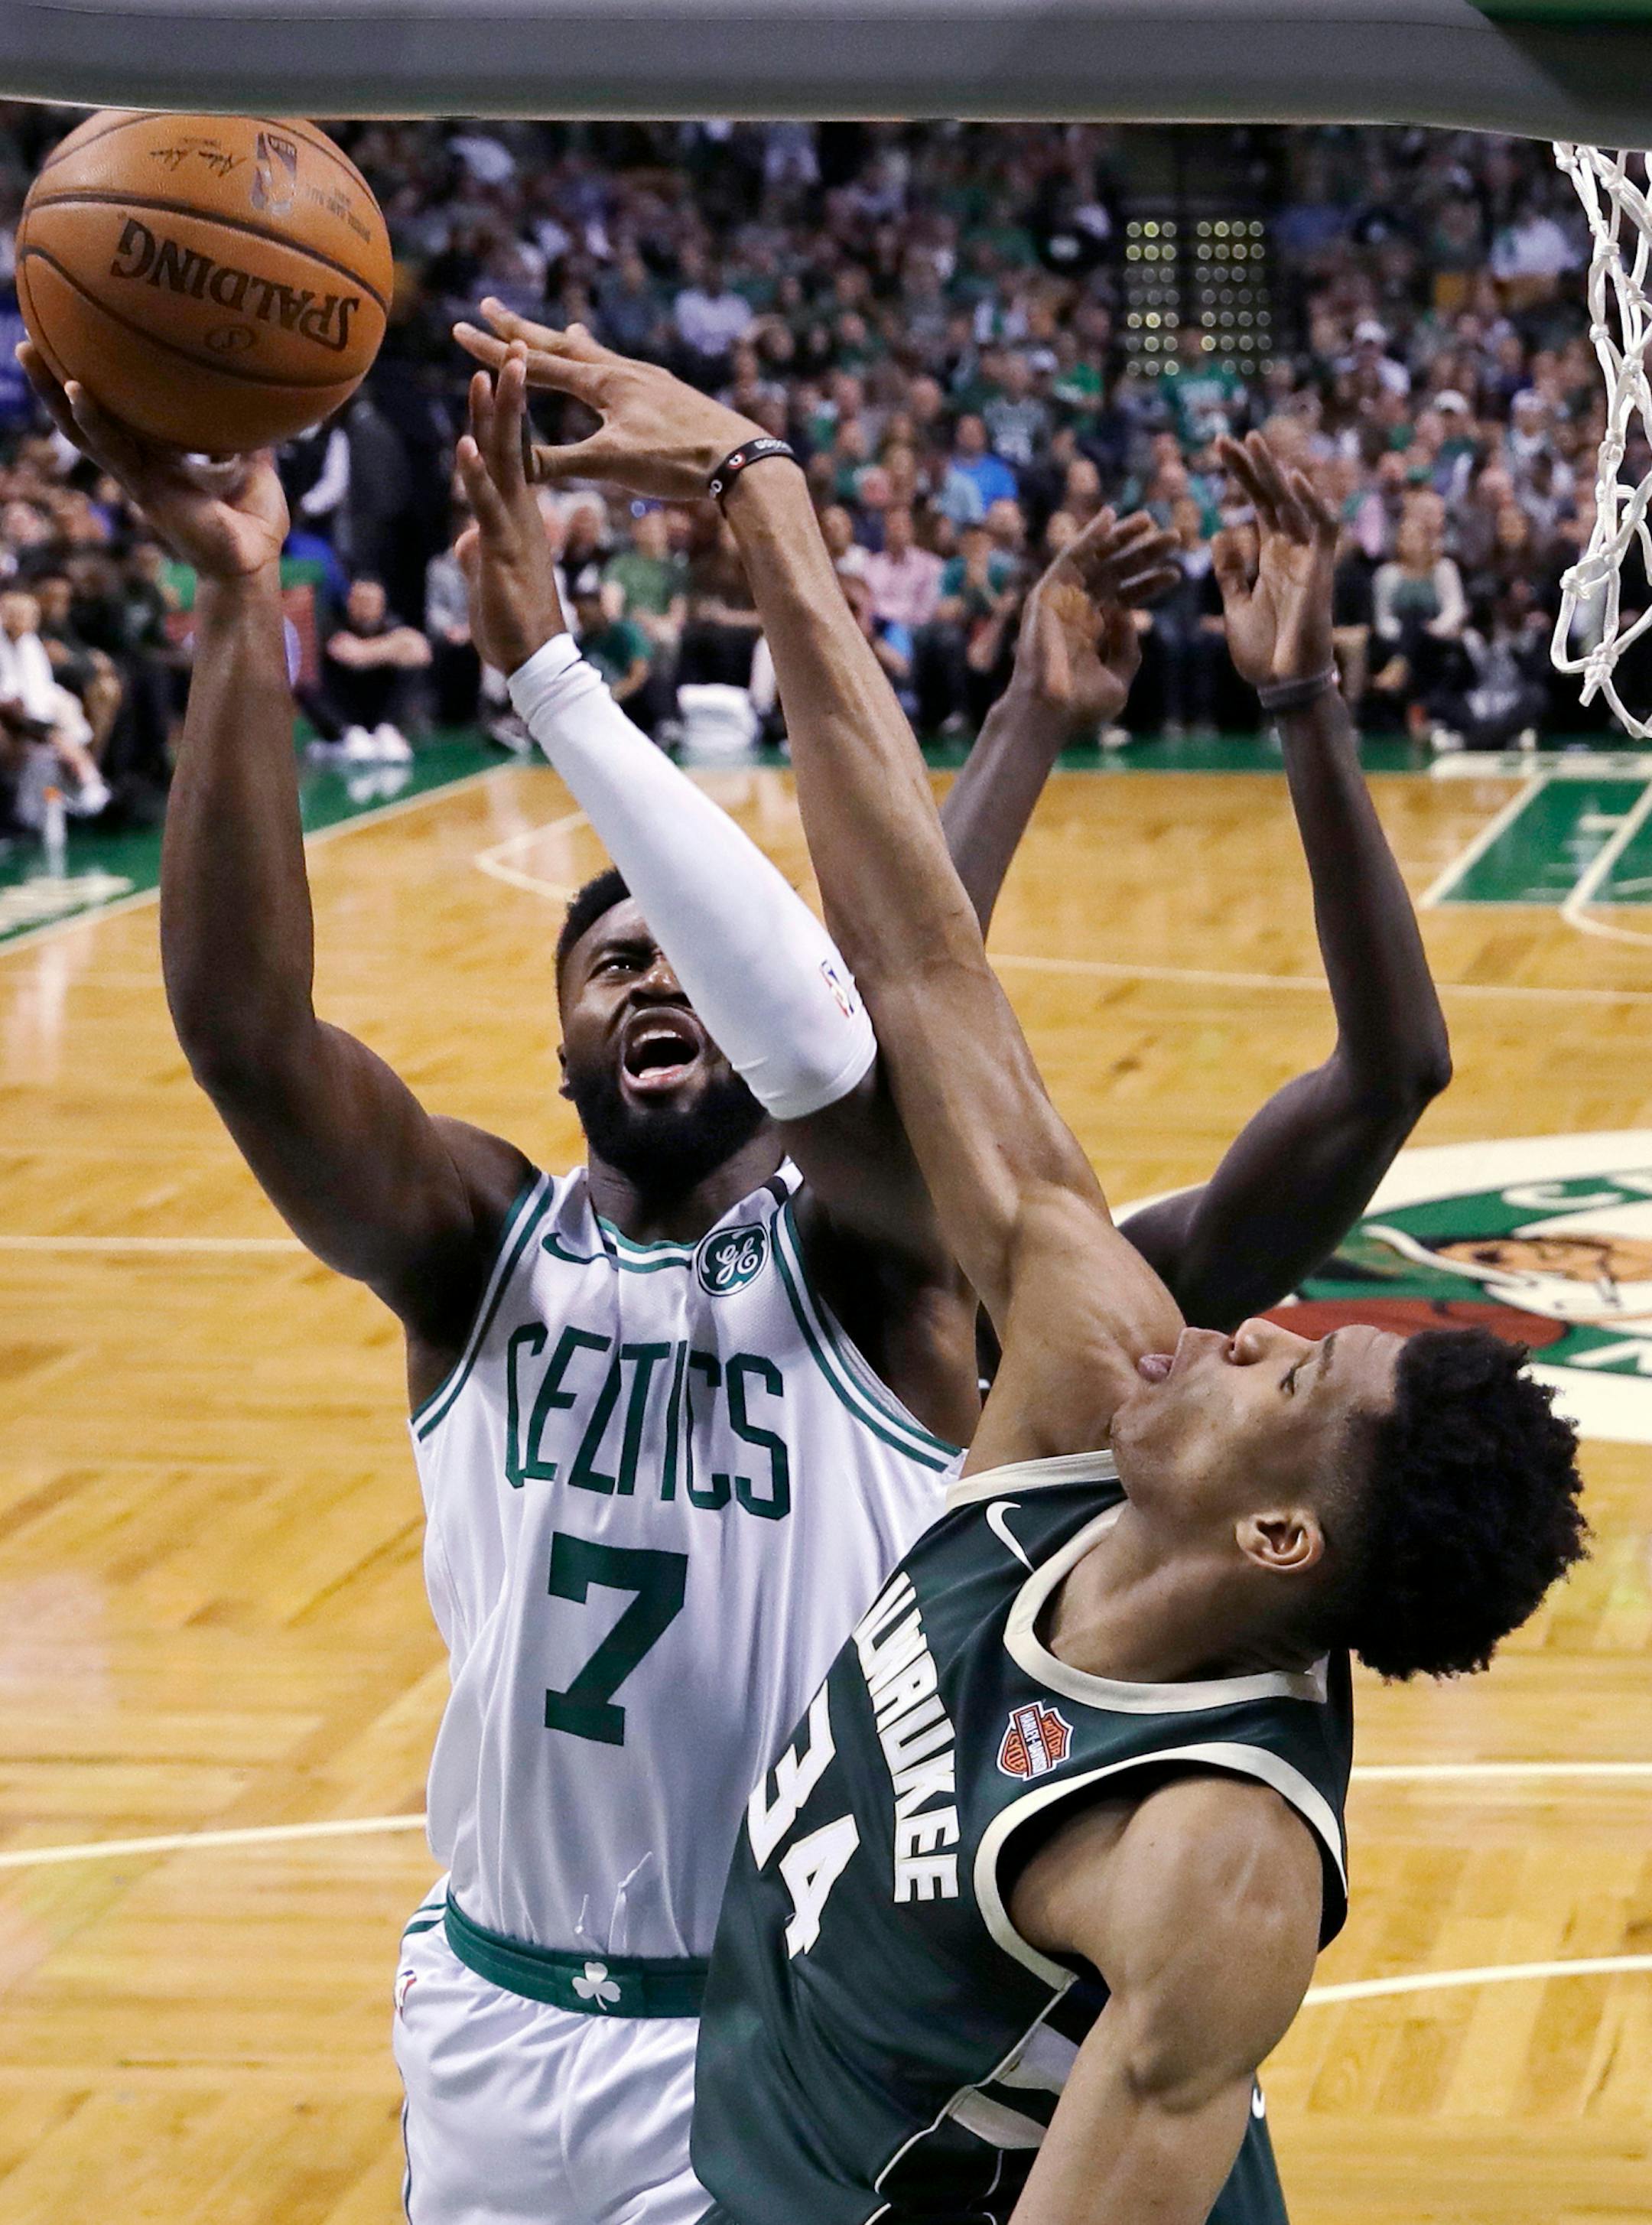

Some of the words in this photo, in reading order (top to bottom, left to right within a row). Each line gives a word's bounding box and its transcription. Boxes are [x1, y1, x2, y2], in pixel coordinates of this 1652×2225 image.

[109, 216, 359, 352] SPALDING
[506, 1322, 791, 1521] CELTICS
[544, 1531, 688, 1747] 7
[851, 1570, 961, 1904] ILWAUKEE
[747, 1679, 860, 1960] 34
